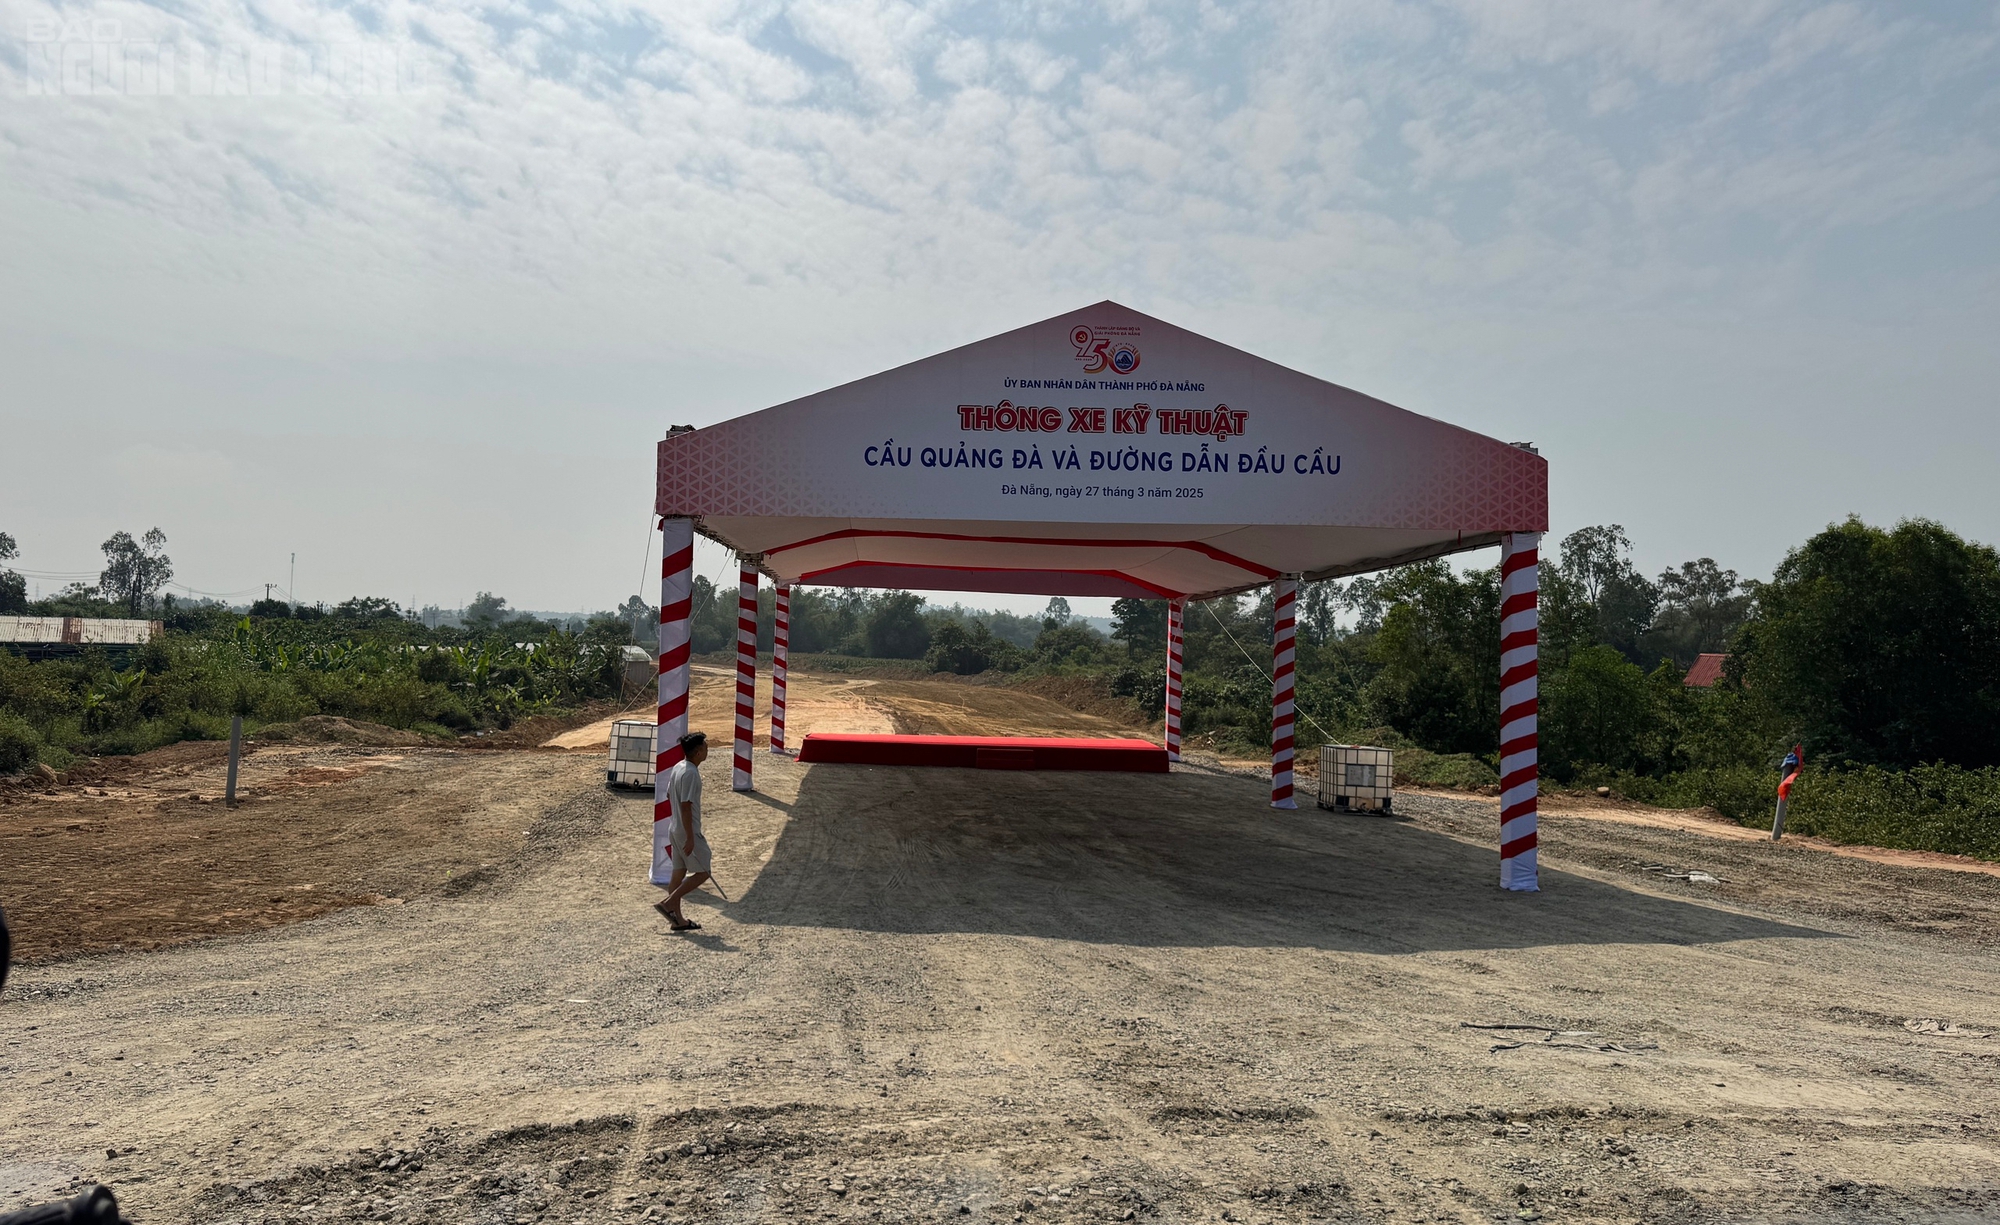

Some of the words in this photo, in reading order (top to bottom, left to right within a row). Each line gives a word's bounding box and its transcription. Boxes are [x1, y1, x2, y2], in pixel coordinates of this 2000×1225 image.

[1004, 376, 1018, 388] ỦY
[1019, 379, 1042, 389] BAN
[1043, 378, 1073, 390] NHÂN
[1074, 378, 1096, 390] DÂN
[1097, 379, 1134, 391] THÀNH
[1136, 379, 1158, 391] PHỐ
[1159, 380, 1174, 392] ĐÀ
[957, 400, 1063, 433] THÔNG
[1067, 407, 1106, 433] XE
[1113, 403, 1153, 434] KỸ
[1156, 404, 1249, 442] THUẬT
[864, 437, 912, 467] CẦU
[920, 440, 1003, 469] QUẢNG
[1011, 443, 1044, 470] ĐÀ
[1051, 443, 1081, 471] VÀ
[1089, 445, 1173, 472] ĐƯỜNG
[1181, 442, 1229, 473] DẪN
[1237, 445, 1285, 474] ĐẦU
[1293, 446, 1341, 476] CẦU
[1001, 483, 1017, 495] Đà
[1055, 485, 1083, 499] ngày
[1085, 485, 1100, 497] 27
[1102, 485, 1135, 500] tháng
[1137, 486, 1145, 498] 3
[1147, 486, 1172, 498] năm
[1175, 487, 1204, 499] 2025
